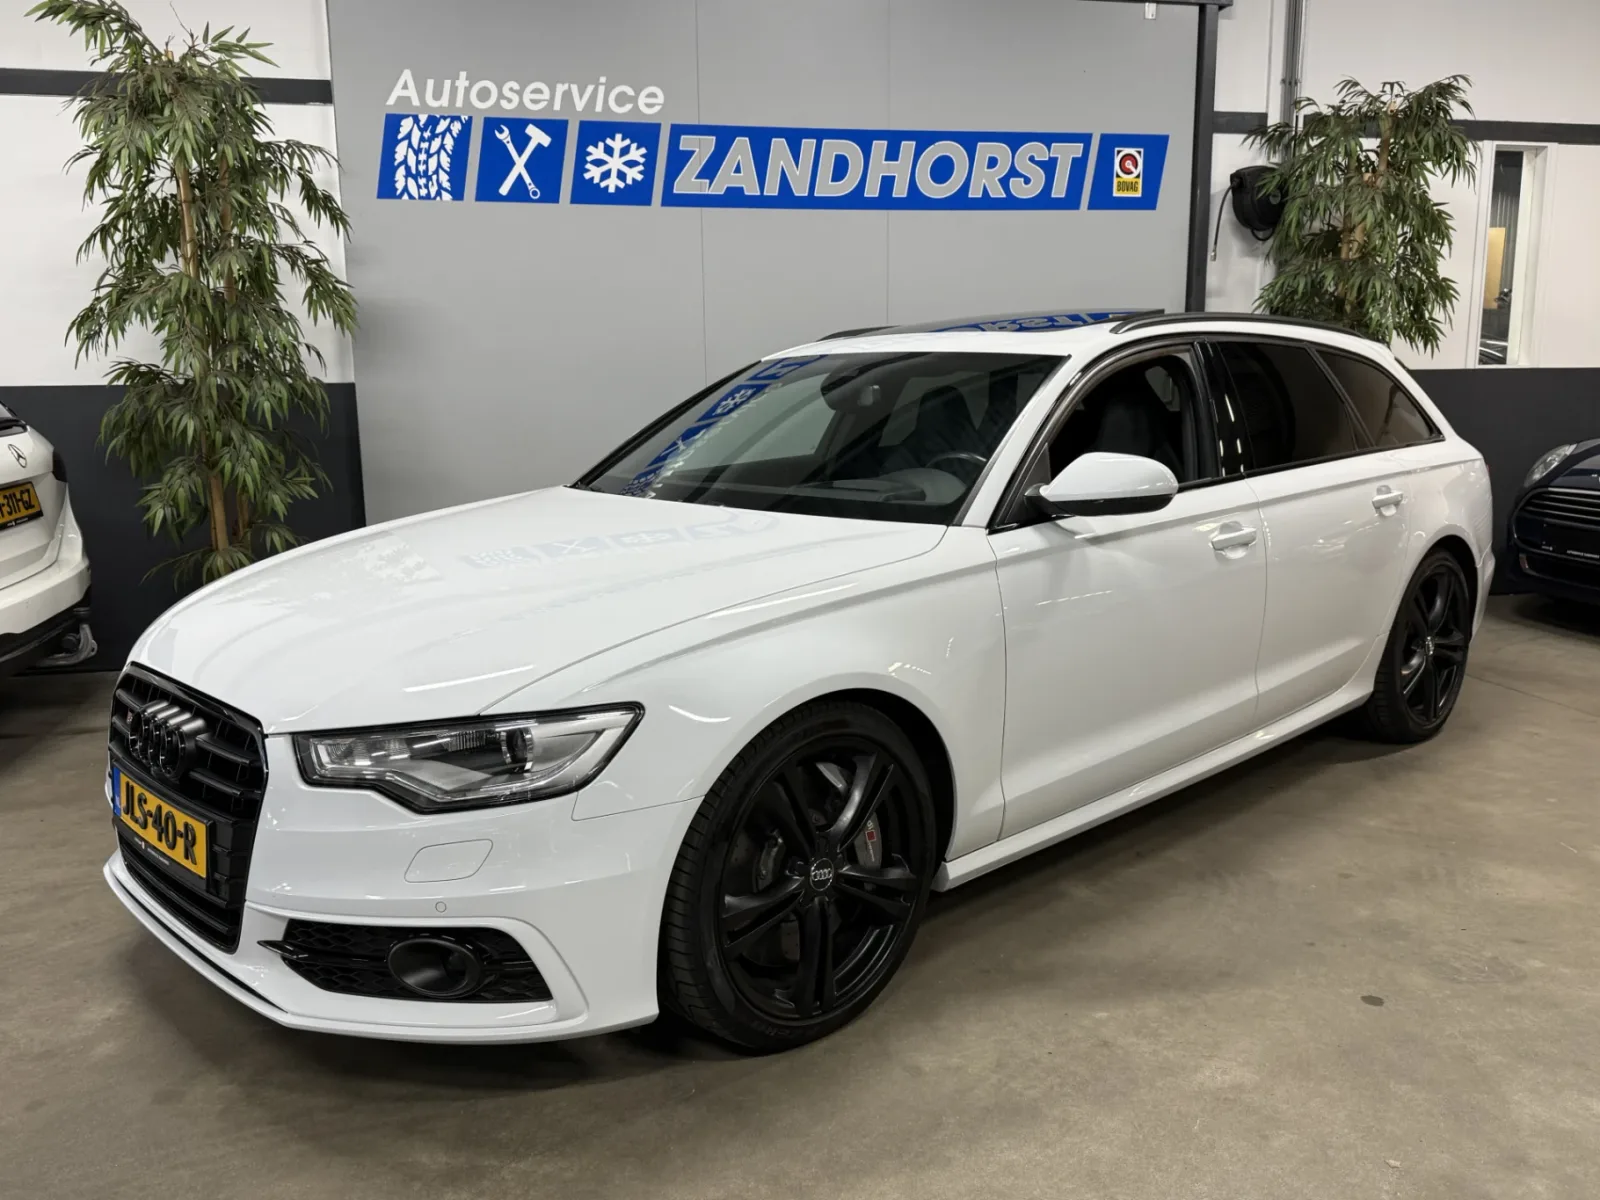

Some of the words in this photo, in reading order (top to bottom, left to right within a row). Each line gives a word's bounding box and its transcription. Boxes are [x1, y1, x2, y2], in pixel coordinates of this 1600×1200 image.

[385, 69, 665, 115] Autoservice
[672, 134, 1084, 199] ZANDHORST
[1116, 180, 1139, 193] BOVAG
[122, 781, 198, 866] JLS-40-R
